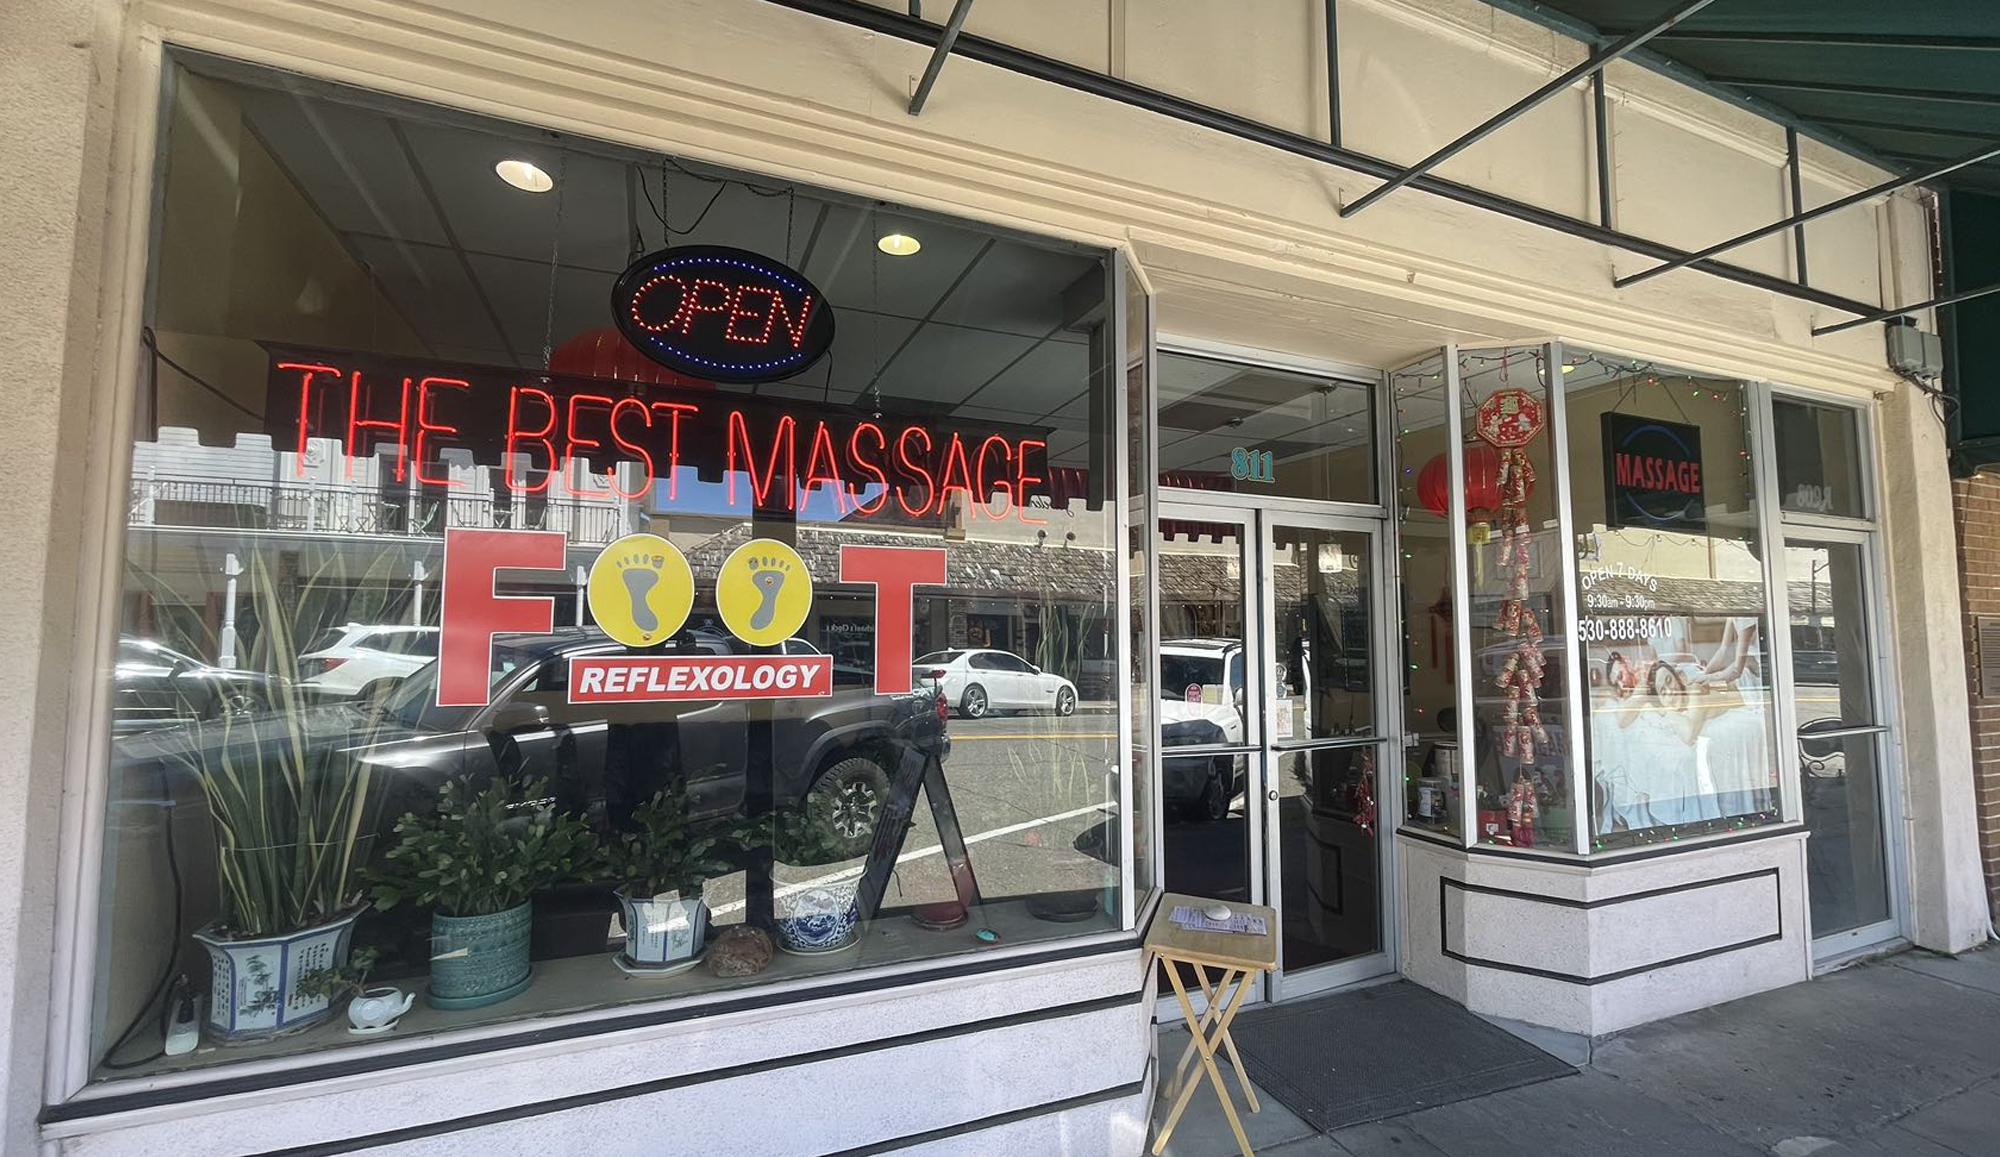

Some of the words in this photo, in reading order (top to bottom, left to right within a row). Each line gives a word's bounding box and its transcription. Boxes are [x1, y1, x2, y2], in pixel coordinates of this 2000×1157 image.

[631, 274, 812, 348] OPEN
[277, 361, 471, 488] THE
[505, 385, 699, 500] BEST
[727, 409, 1048, 525] MASSAGE
[1231, 447, 1276, 483] 811
[1615, 452, 1701, 494] MASSAGE
[1582, 564, 1614, 590] OPEN
[1617, 562, 1624, 577] 7
[1627, 566, 1657, 592] DAYS
[1587, 594, 1618, 608] 9:30am
[1625, 594, 1655, 610] 9:30pm
[1578, 617, 1672, 642] 530-888-8610
[578, 663, 822, 695] REFLEXOLOGY
